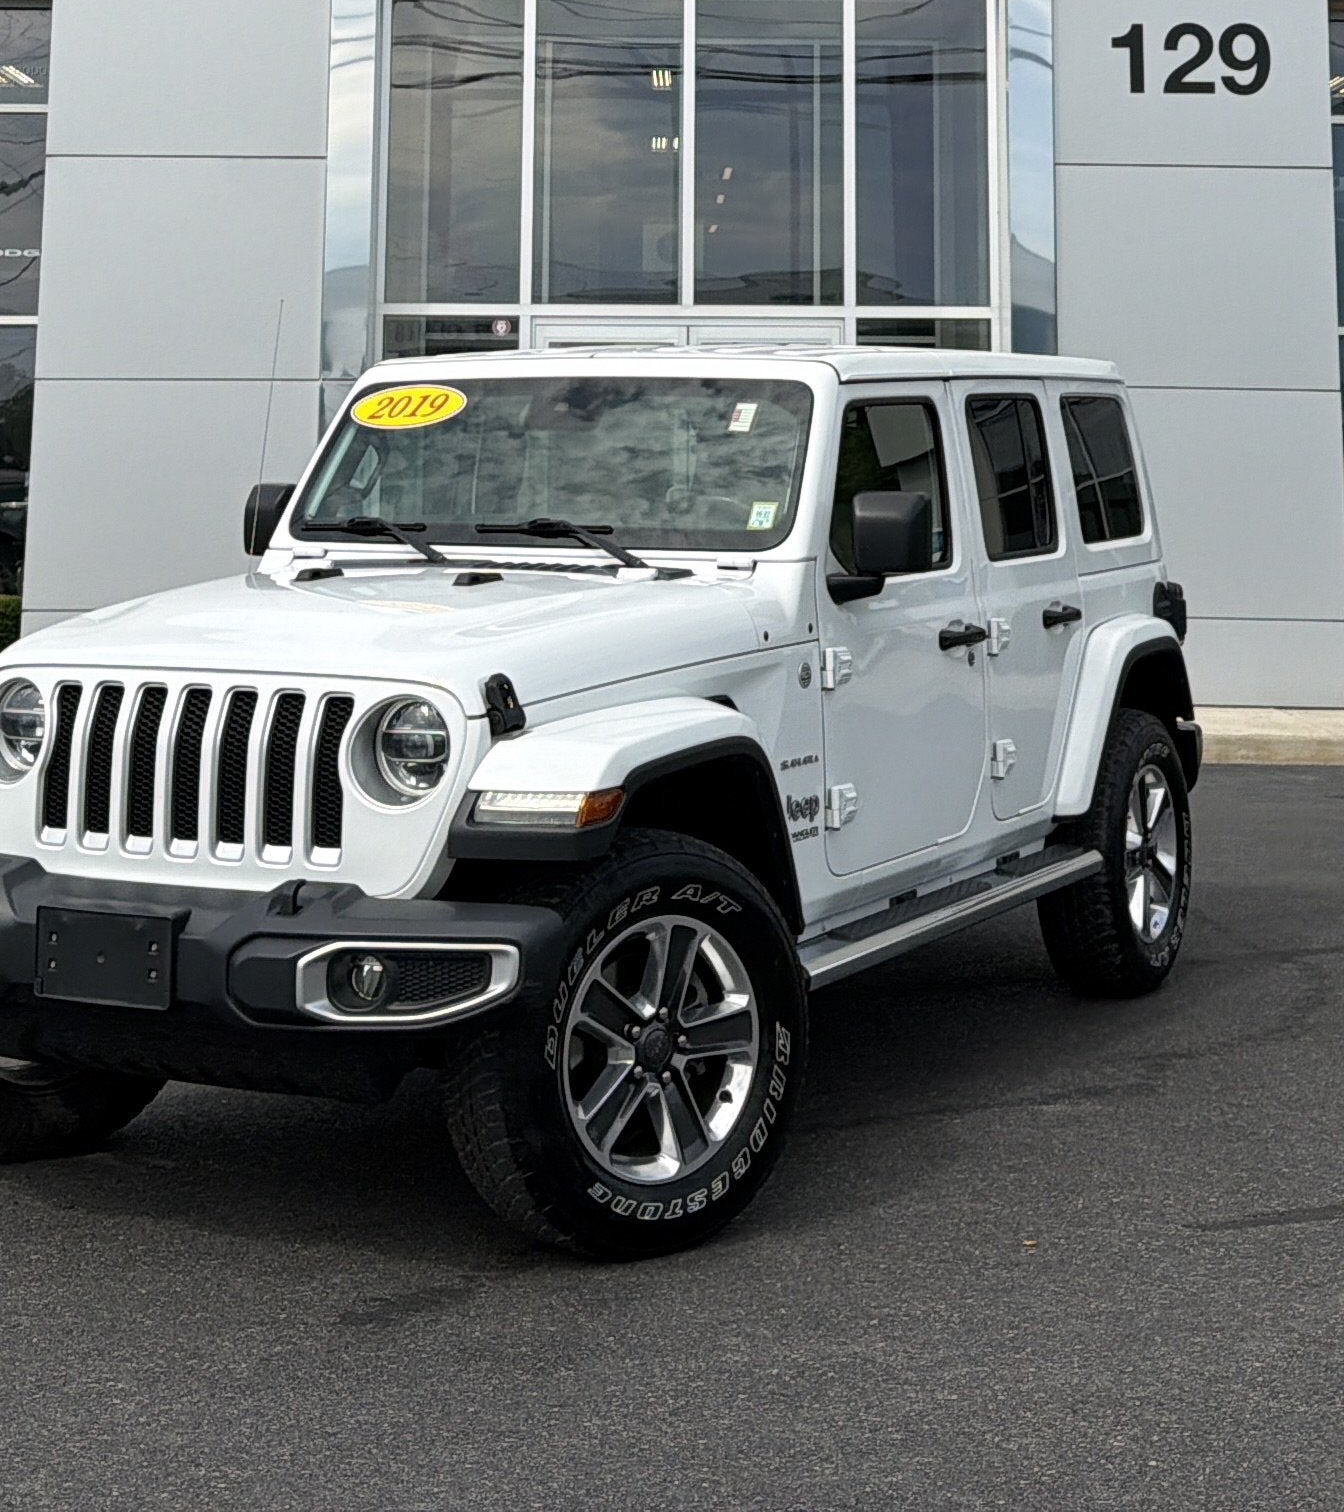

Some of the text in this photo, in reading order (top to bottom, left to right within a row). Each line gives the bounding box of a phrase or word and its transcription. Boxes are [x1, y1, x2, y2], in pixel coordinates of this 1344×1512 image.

[1111, 22, 1272, 96] 129
[367, 393, 450, 420] 2019
[587, 1021, 791, 1221] BRIDGESTONE
